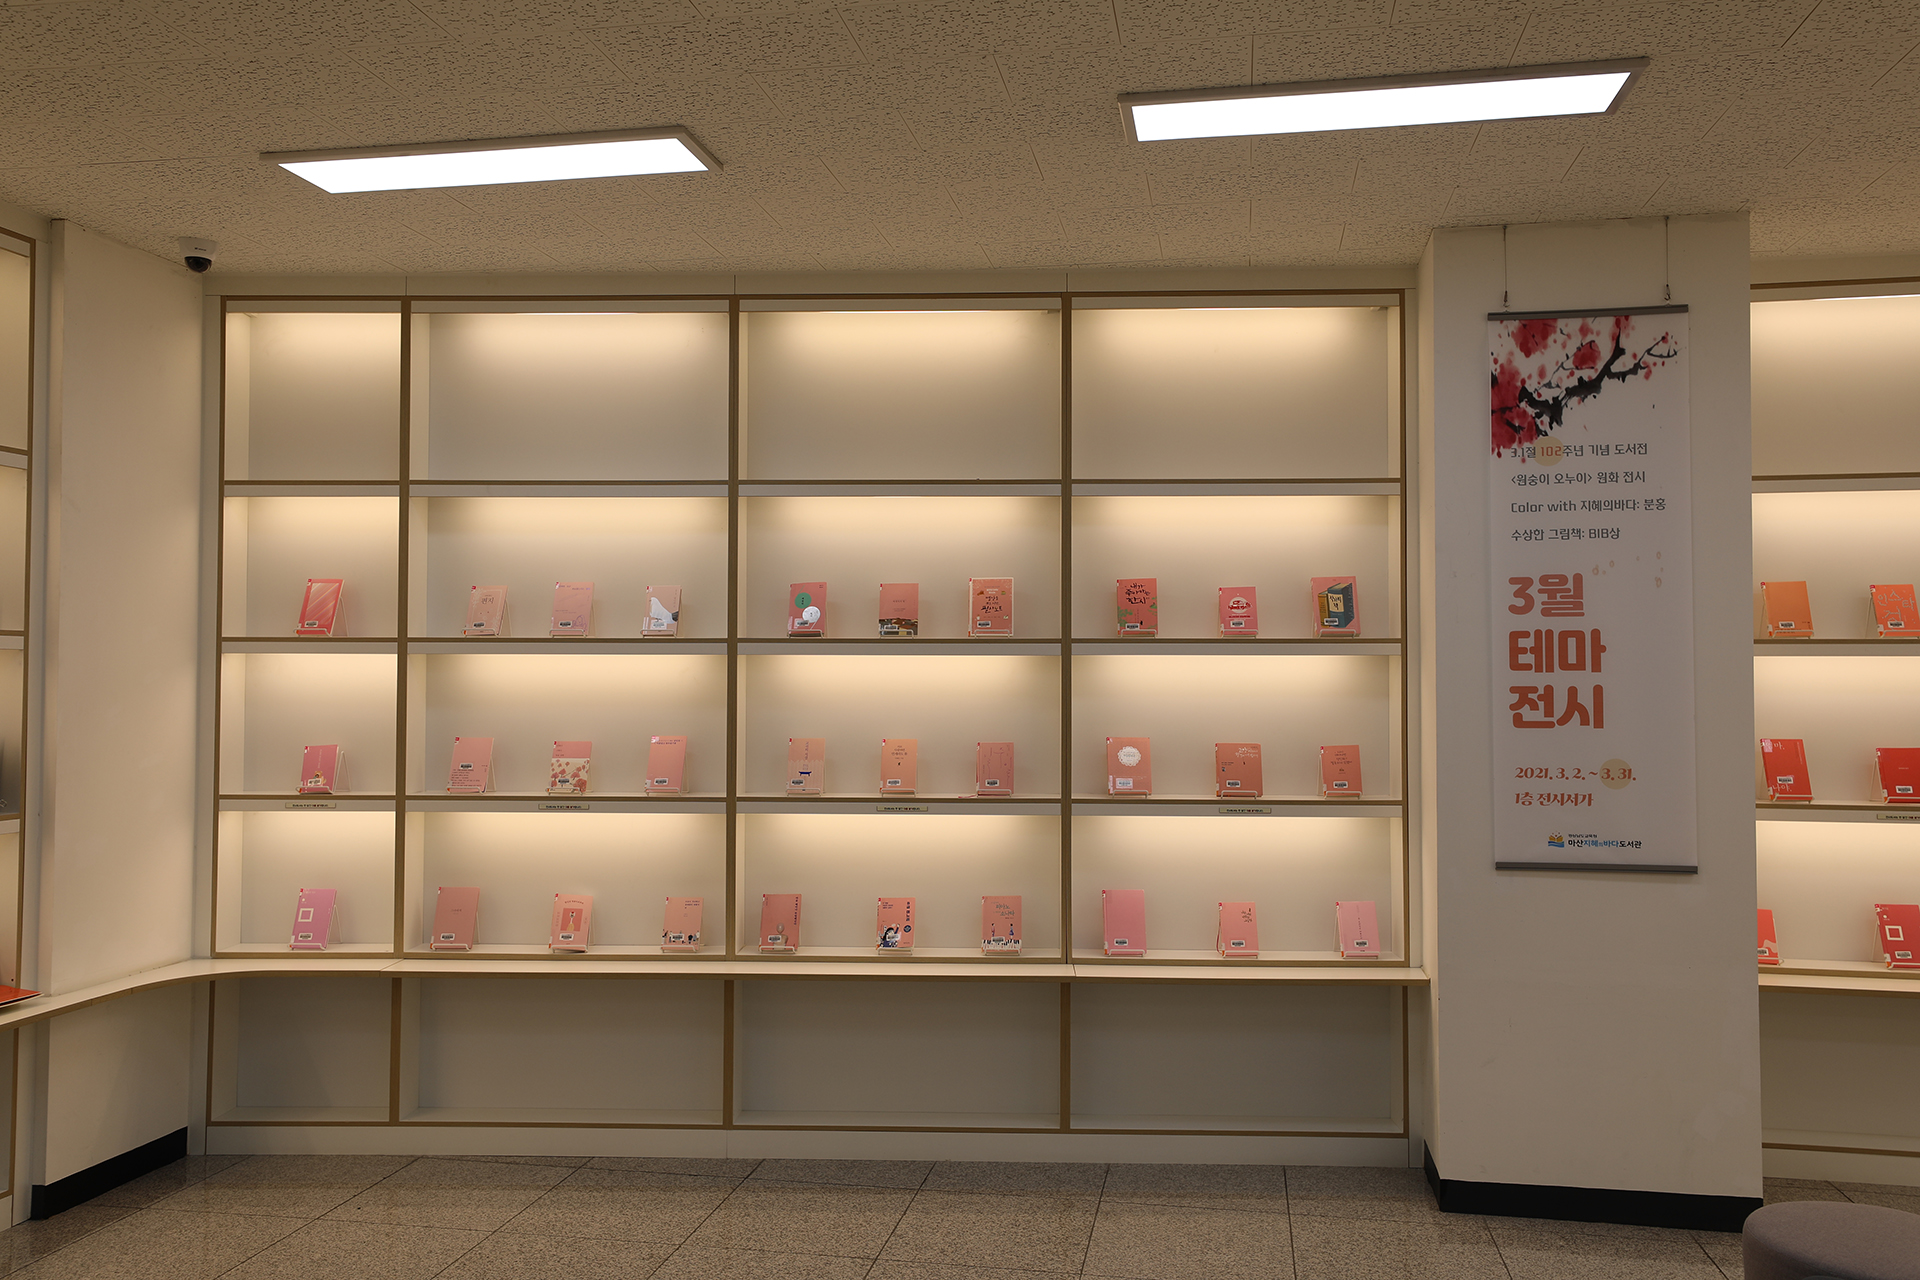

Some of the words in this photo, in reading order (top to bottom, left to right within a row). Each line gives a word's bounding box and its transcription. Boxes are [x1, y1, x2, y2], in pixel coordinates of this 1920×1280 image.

[1510, 446, 1536, 459] 3.1절
[1588, 444, 1611, 457] 기념
[1614, 442, 1648, 456] 도서전
[1511, 473, 1550, 487] <원숭이
[1554, 472, 1593, 485] 오누이>
[1597, 471, 1620, 484] 원화
[1623, 470, 1646, 484] 전시
[1511, 502, 1544, 513] Color
[1547, 500, 1577, 512] with
[1580, 499, 1640, 512] 지혜의바다:
[1643, 498, 1667, 511] 분홍
[1511, 529, 1545, 542] 수상한
[1548, 528, 1587, 541] 그림책:
[1589, 527, 1621, 539] BIB상
[1508, 572, 1586, 617] 3월
[1508, 628, 1607, 673] 테마
[1508, 684, 1604, 729] 전시
[1514, 767, 1554, 781] 2021.
[1556, 768, 1570, 781] 3.
[1572, 768, 1586, 781] 2.
[1515, 792, 1534, 806] 1층
[1537, 792, 1595, 807] 전시서가
